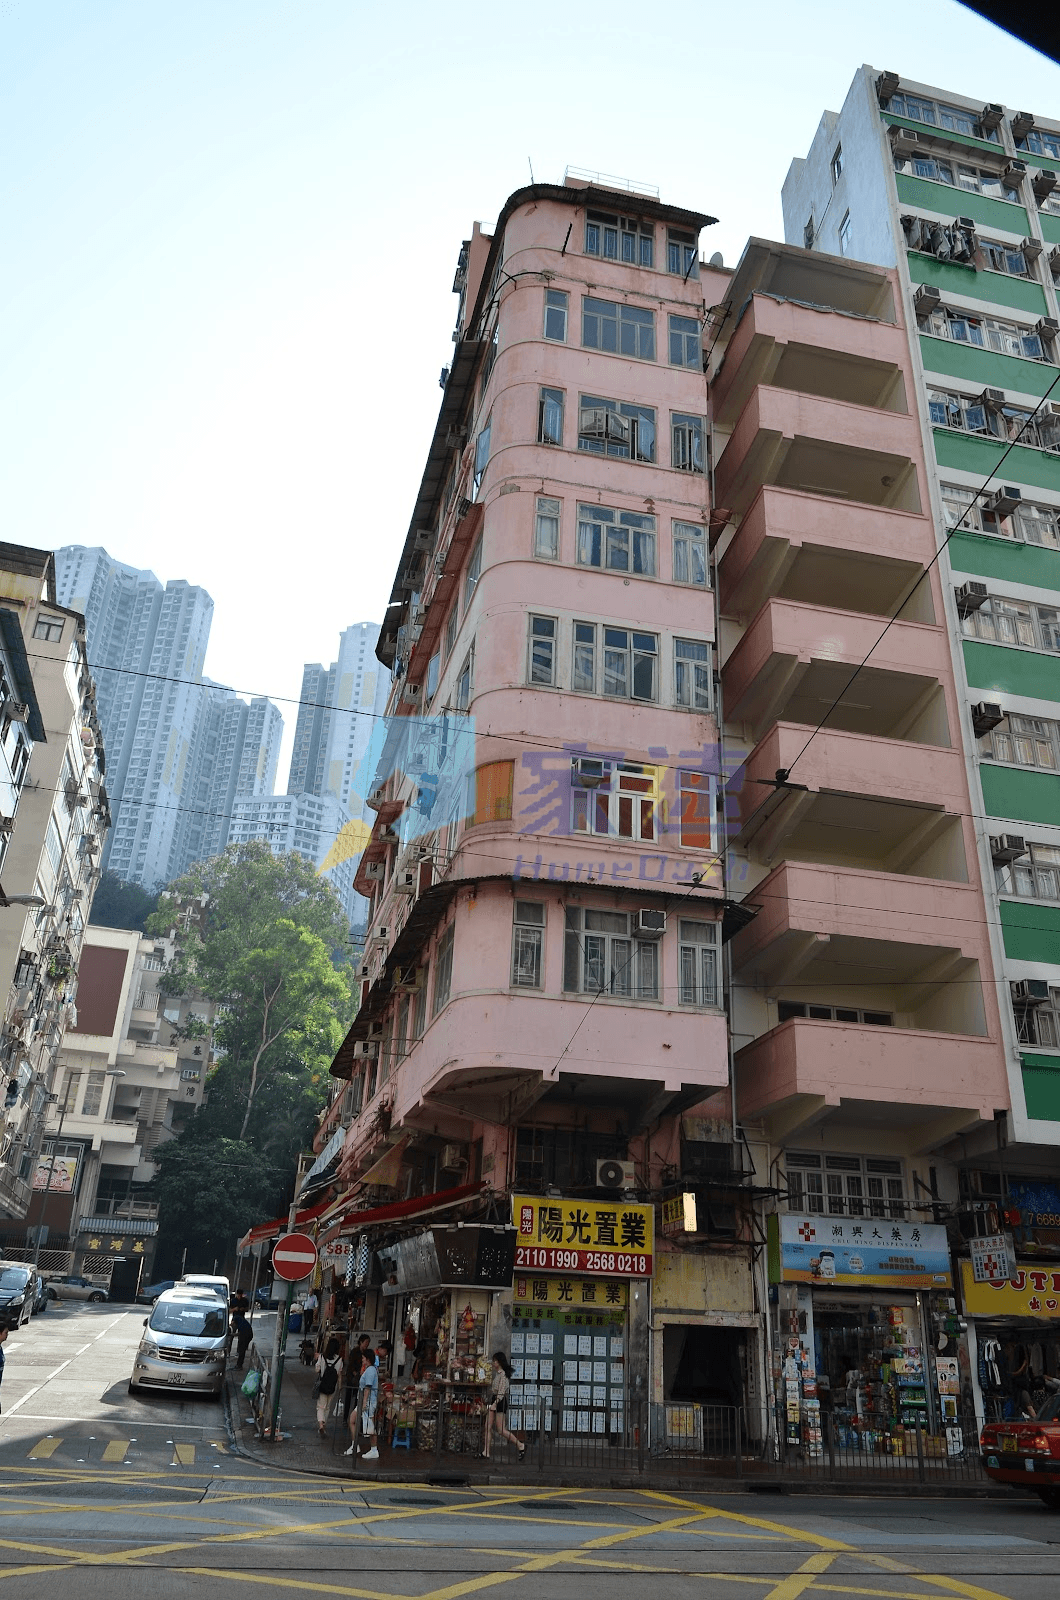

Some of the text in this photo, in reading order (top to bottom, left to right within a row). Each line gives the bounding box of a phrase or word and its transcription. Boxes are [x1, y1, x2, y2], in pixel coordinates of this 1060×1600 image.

[537, 1206, 646, 1249] 陽光置業
[516, 1247, 646, 1273] 2110 1990 2568 0218
[532, 1280, 621, 1304] 陽光置業
